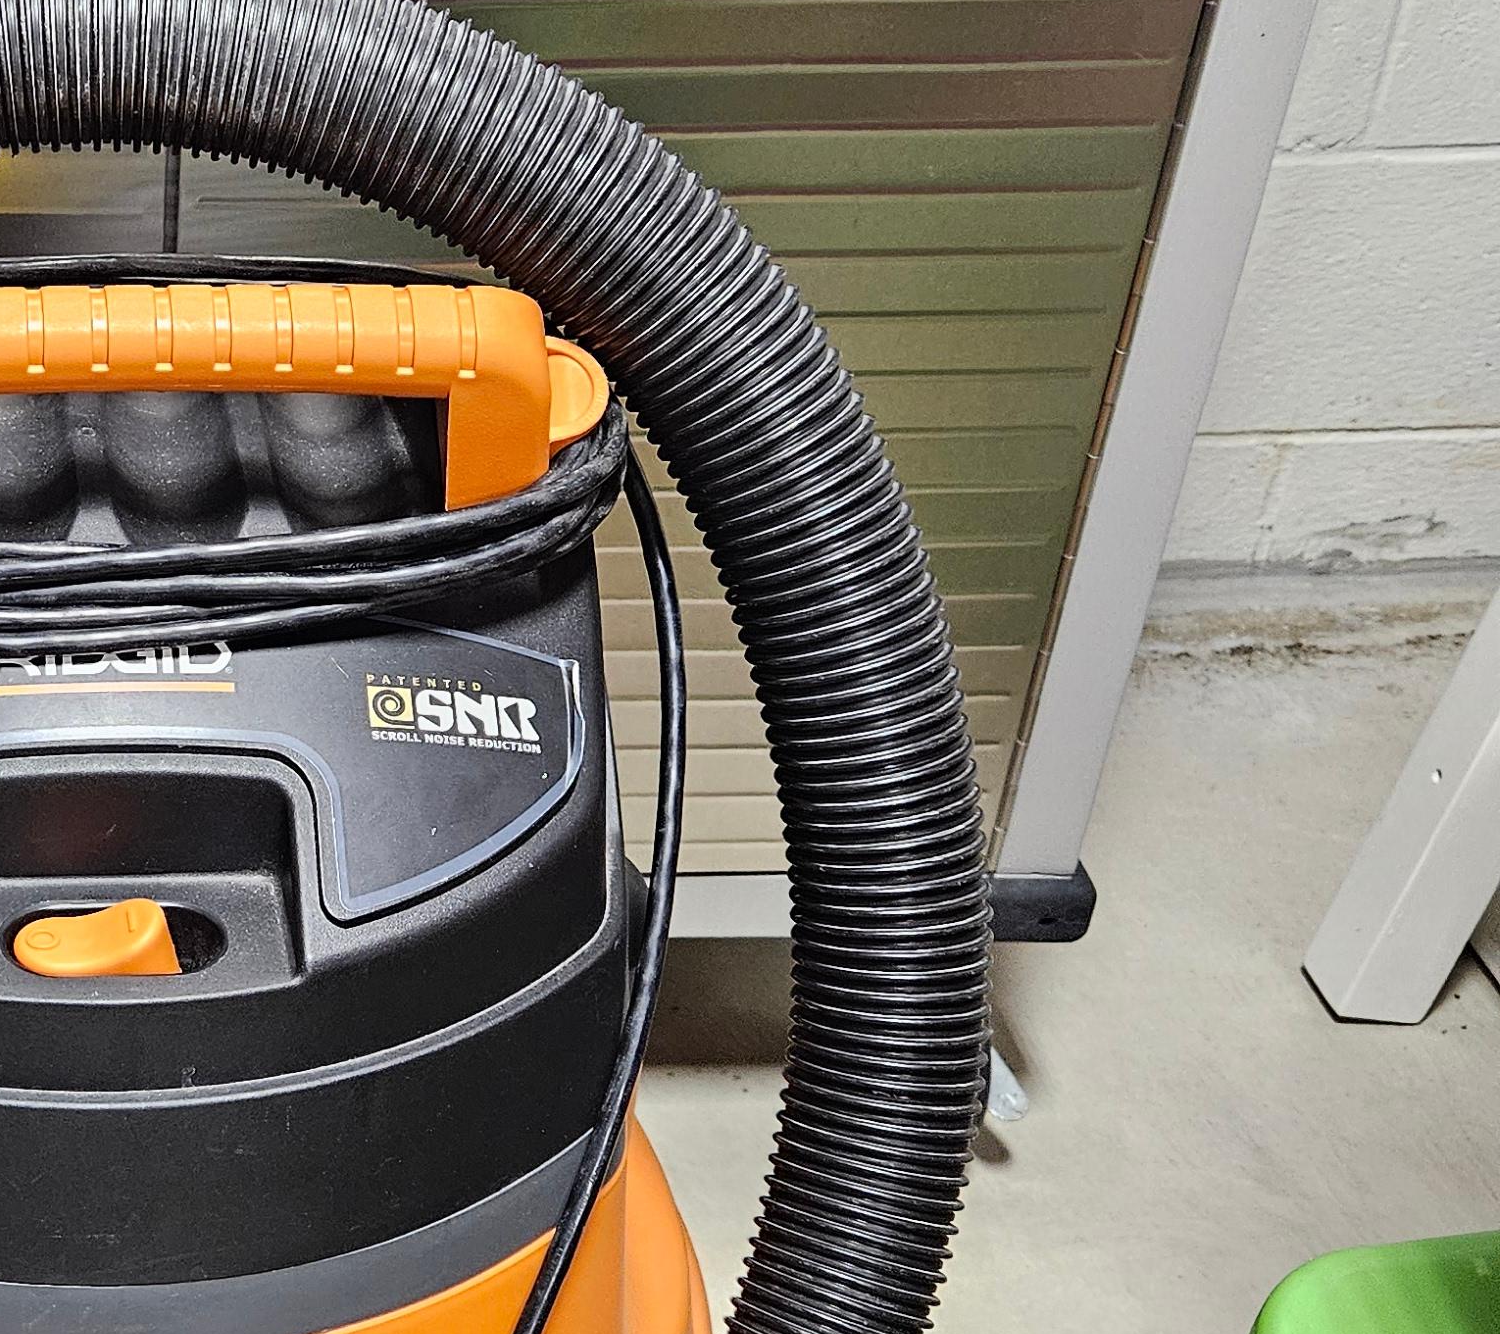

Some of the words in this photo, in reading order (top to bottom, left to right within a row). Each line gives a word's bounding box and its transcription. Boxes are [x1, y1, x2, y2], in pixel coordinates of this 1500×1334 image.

[366, 674, 483, 692] PATENTED
[415, 689, 540, 742] SNR
[371, 730, 422, 743] SCROLL
[425, 734, 465, 747] NOISE
[469, 737, 542, 754] REDUCTION
